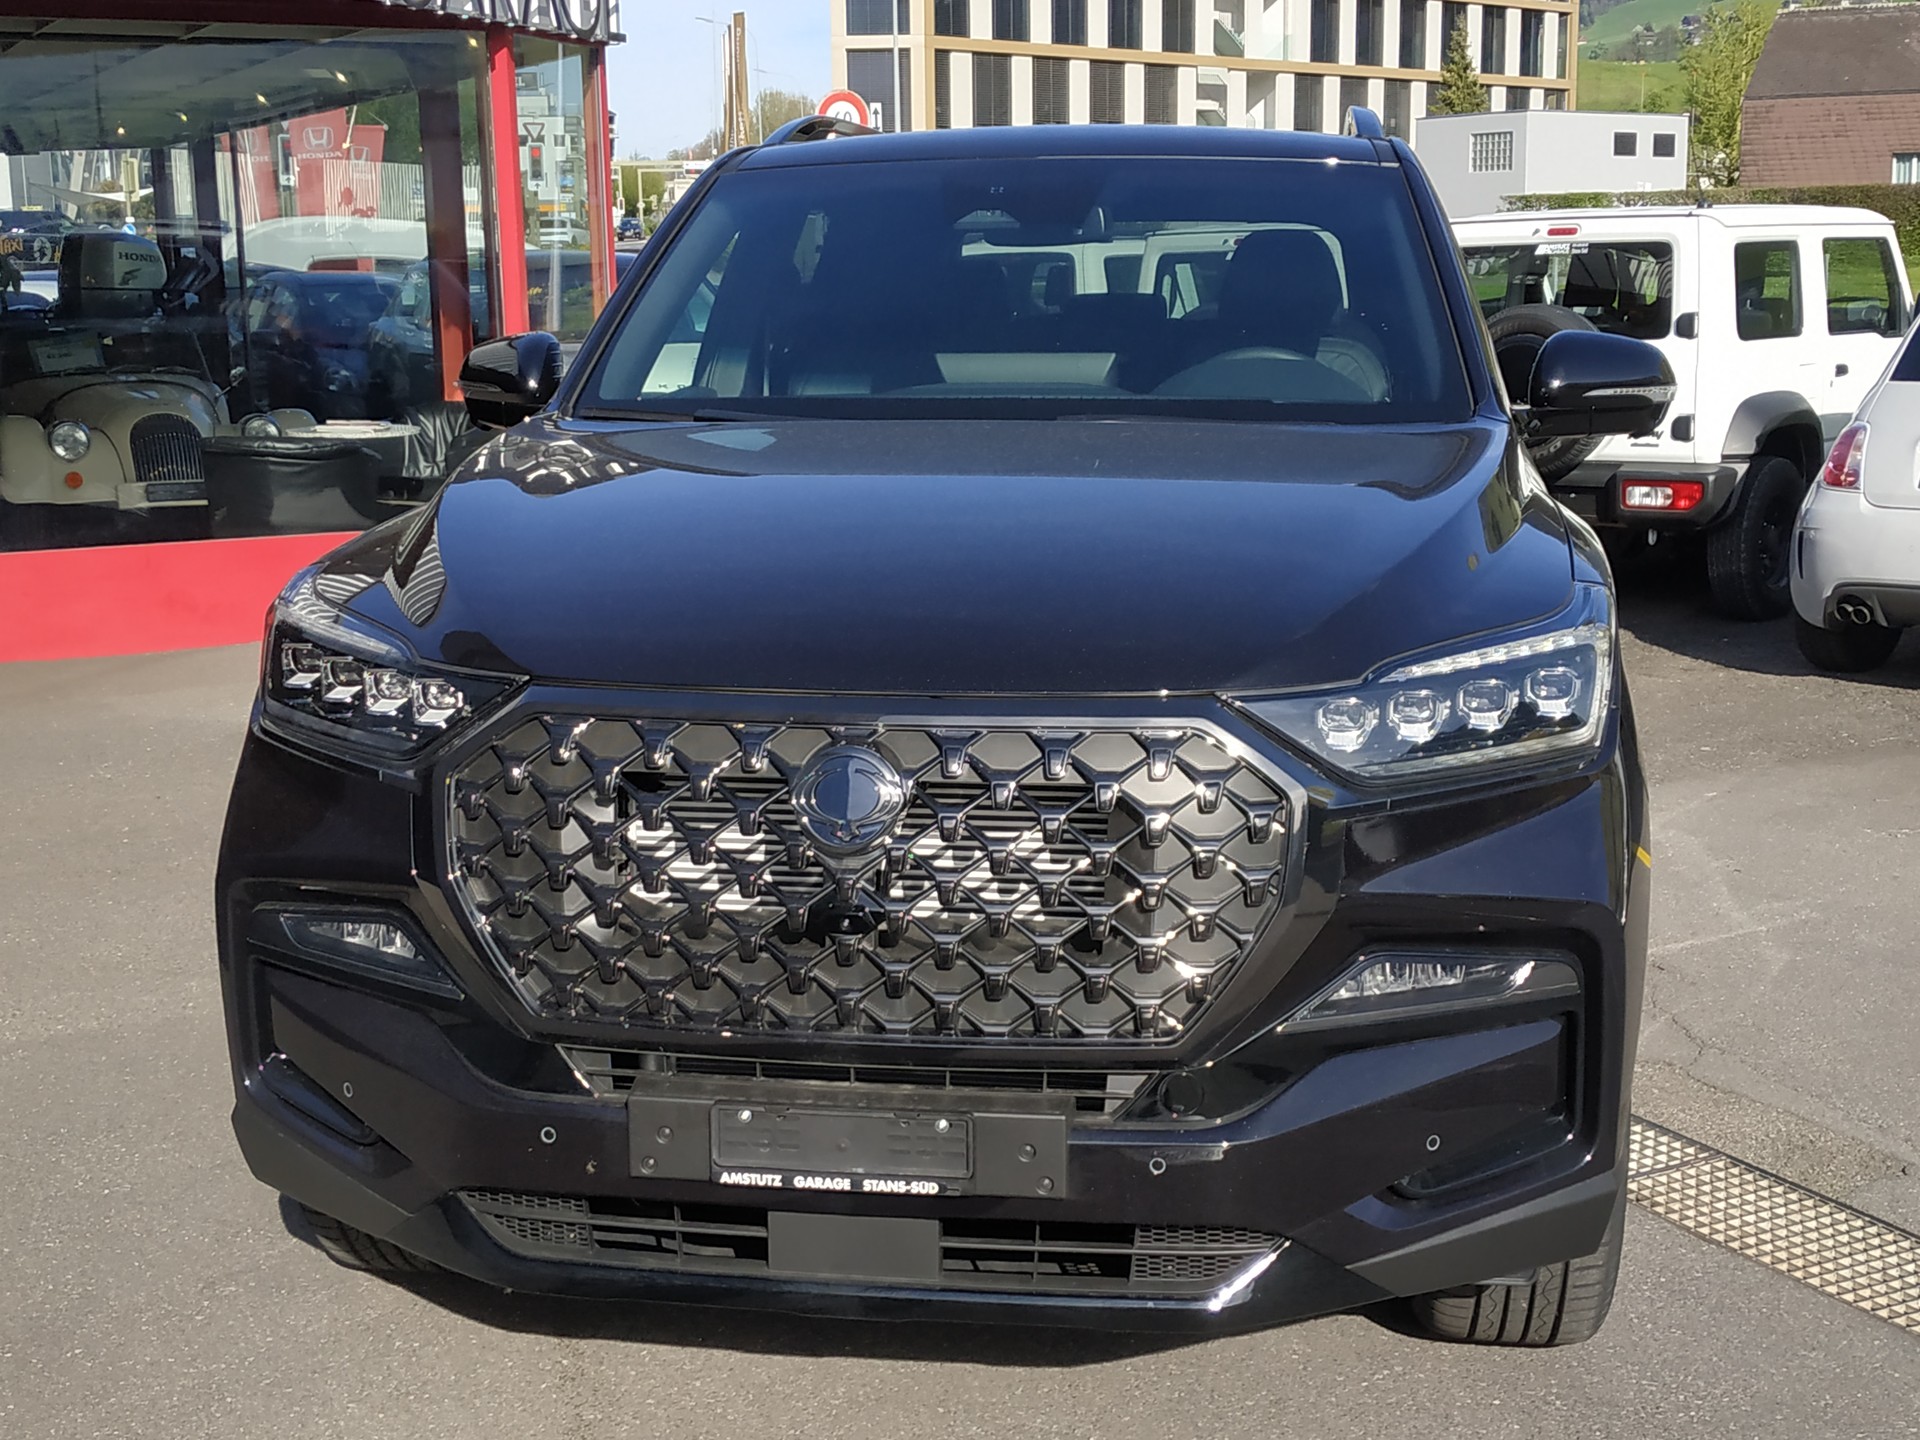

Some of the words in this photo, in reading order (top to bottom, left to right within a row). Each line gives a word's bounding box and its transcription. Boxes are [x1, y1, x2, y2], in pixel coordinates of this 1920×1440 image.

[297, 151, 343, 160] HONDA
[118, 251, 162, 264] HONDA
[719, 1172, 783, 1187] AMSTUTZ
[793, 1175, 851, 1191] GARAGE
[862, 1178, 939, 1195] STANS-SÜD
